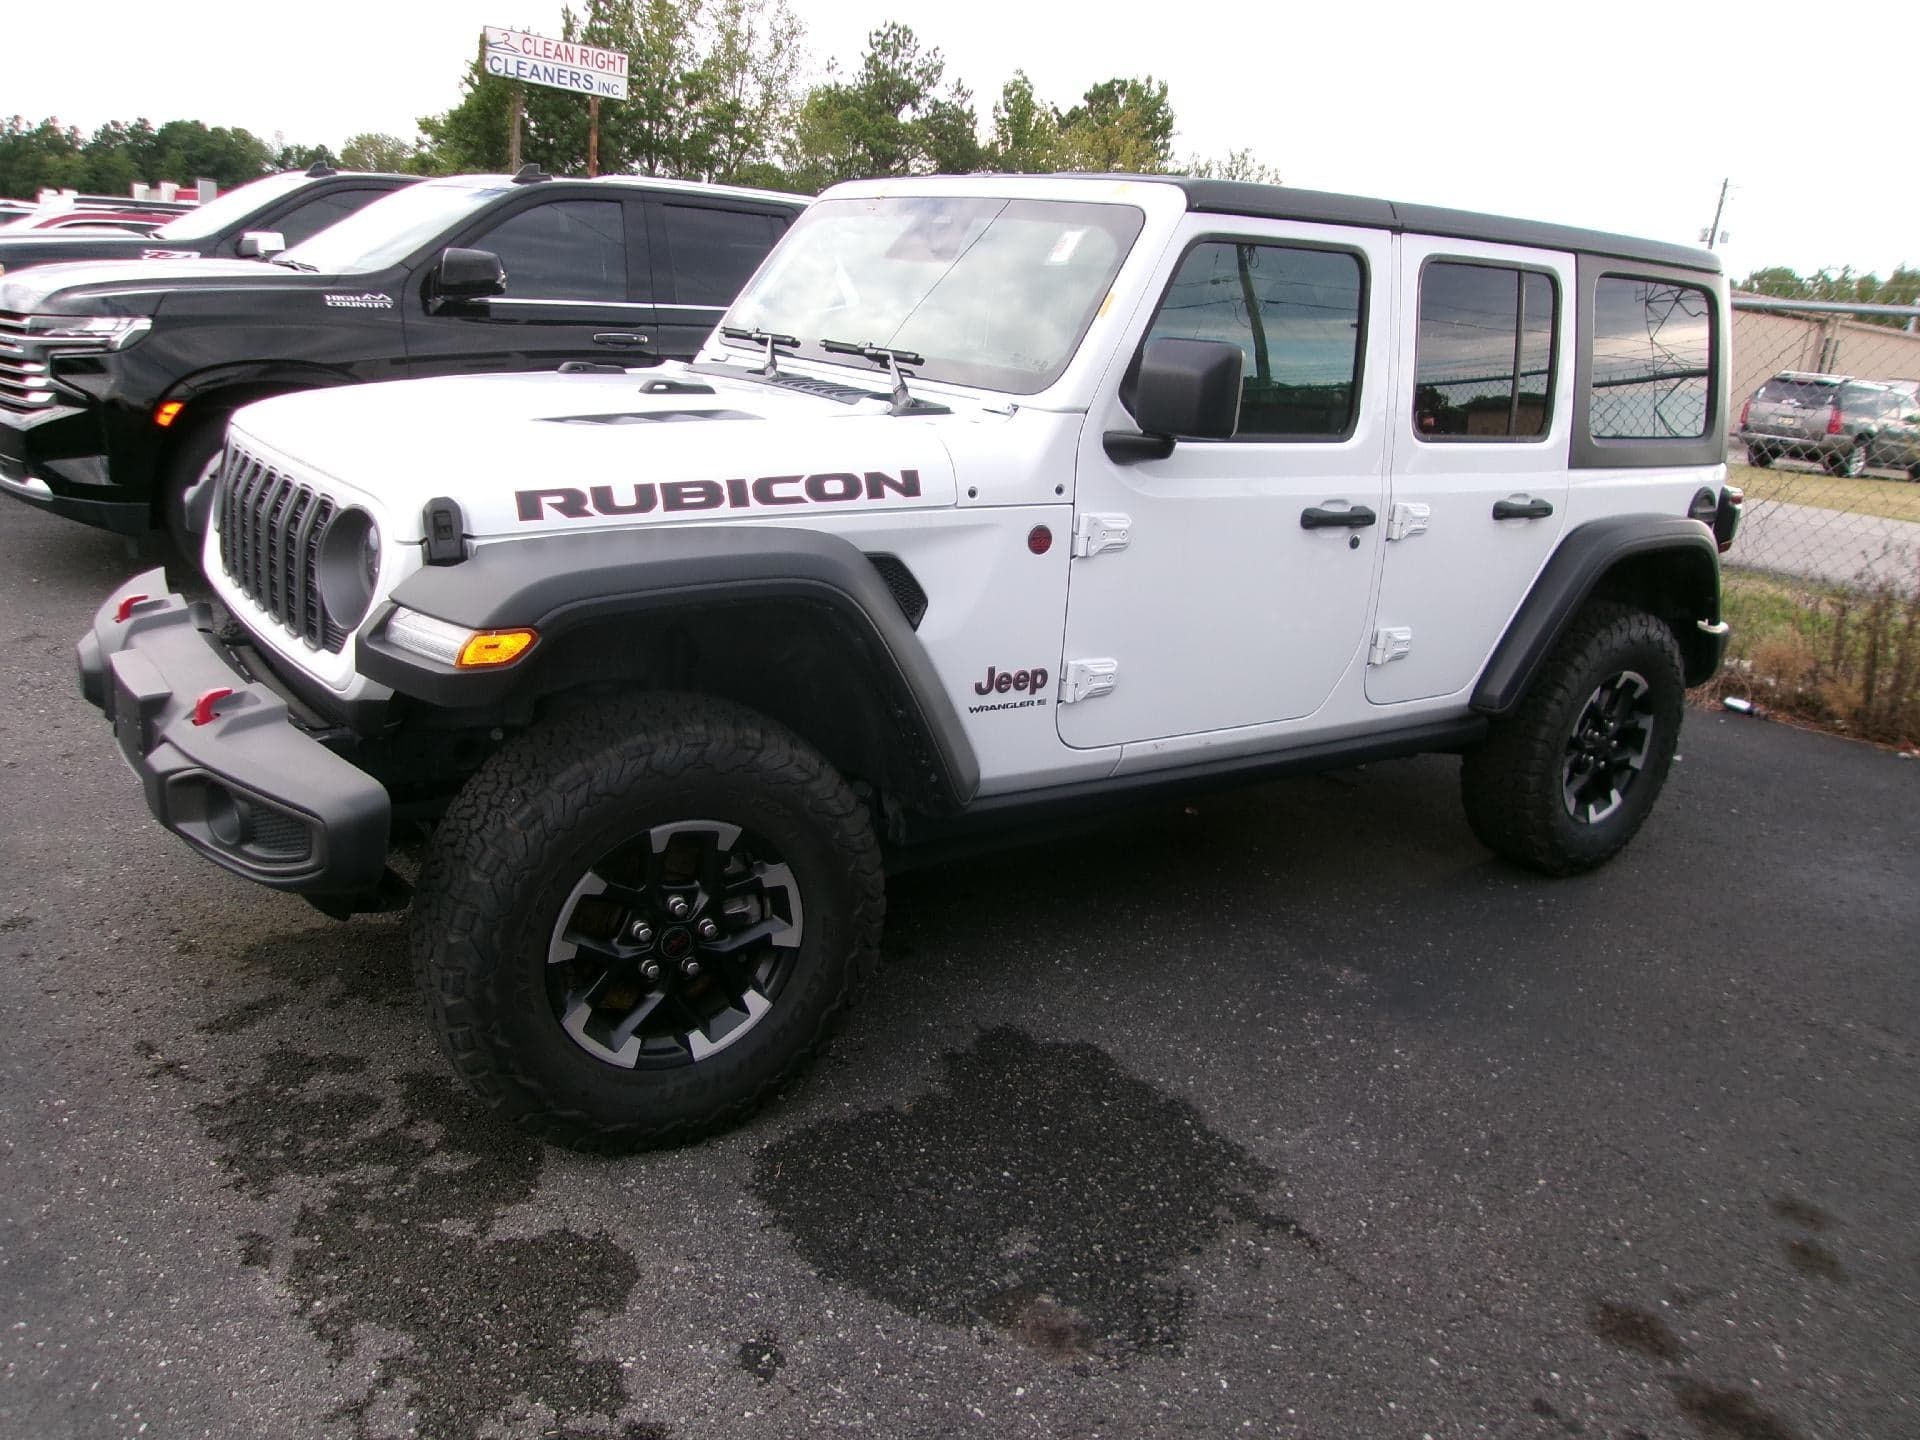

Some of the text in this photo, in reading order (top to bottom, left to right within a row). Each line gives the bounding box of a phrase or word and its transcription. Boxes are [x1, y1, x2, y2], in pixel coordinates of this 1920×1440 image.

[521, 37, 626, 74] CLEAN RIGHT
[489, 56, 624, 97] CLEANERS INC.
[328, 301, 393, 309] COUNTRY
[514, 470, 922, 521] RUBICON
[975, 665, 1049, 696] Jeep
[969, 699, 1035, 714] WRANGLER
